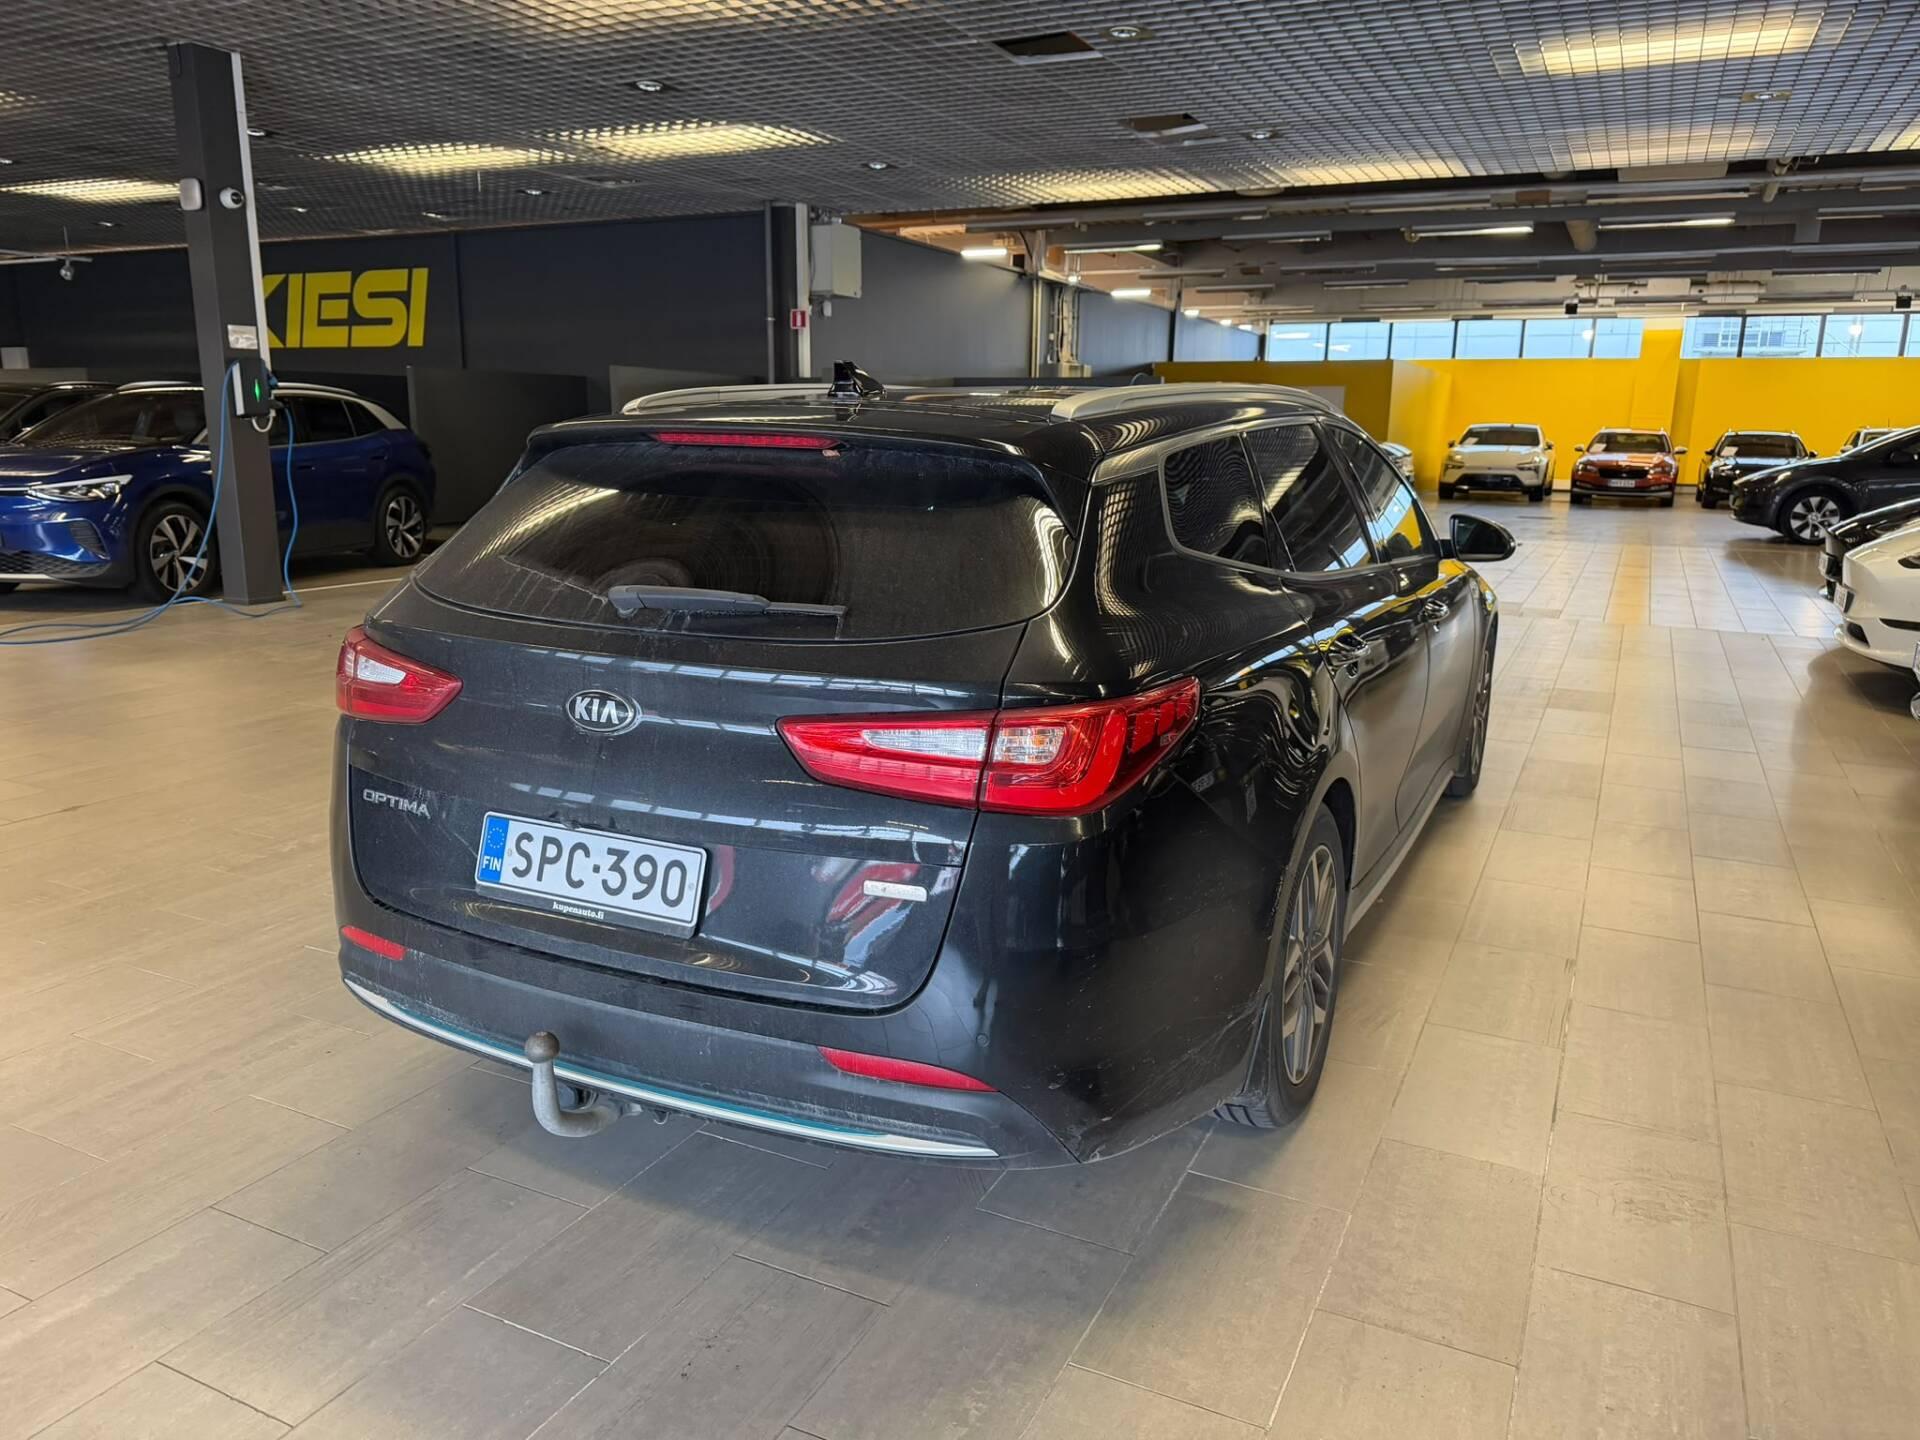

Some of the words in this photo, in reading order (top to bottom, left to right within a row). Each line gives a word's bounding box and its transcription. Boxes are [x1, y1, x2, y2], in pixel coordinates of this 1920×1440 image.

[575, 696, 620, 724] KIA
[362, 788, 431, 820] OPTIMA
[482, 855, 502, 871] FIN
[552, 901, 604, 920] kupenauto.fi
